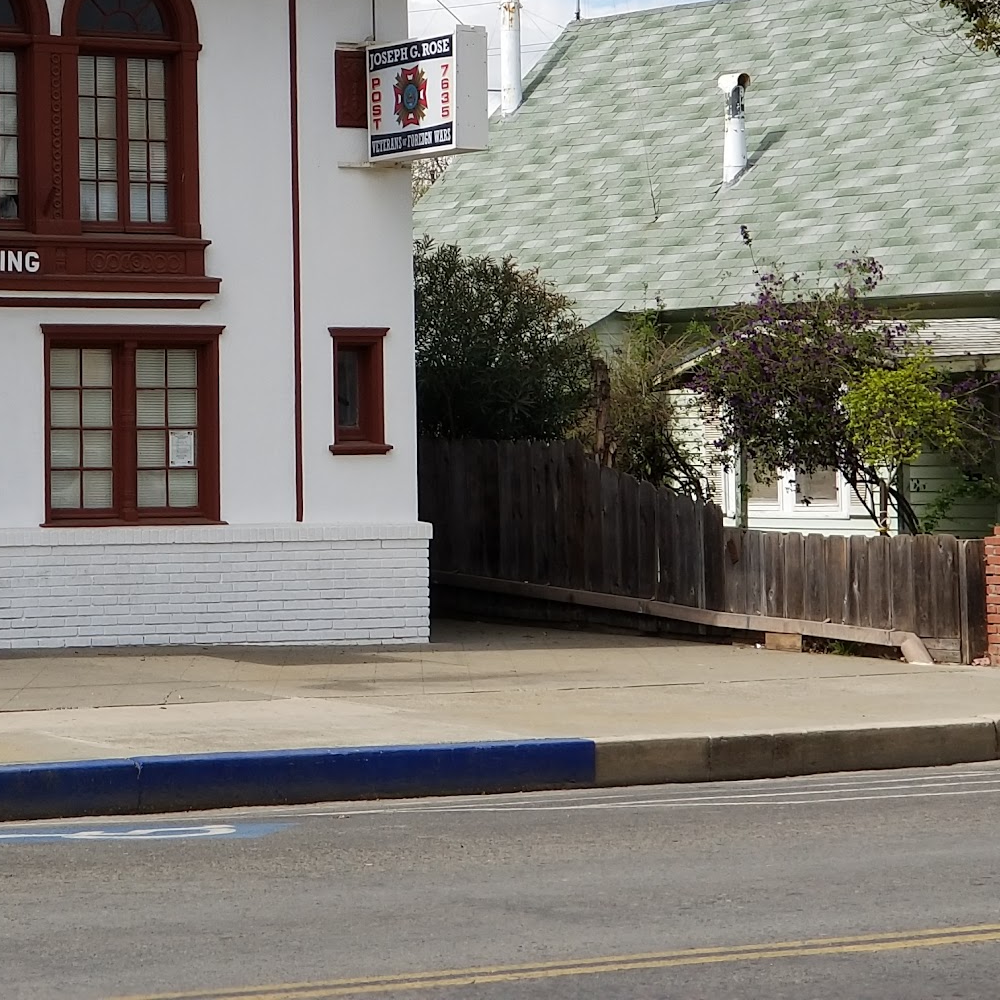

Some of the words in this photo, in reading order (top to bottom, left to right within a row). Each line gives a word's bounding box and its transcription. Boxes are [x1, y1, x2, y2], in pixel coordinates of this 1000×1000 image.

[370, 47, 408, 70] JOSEPH
[410, 45, 420, 58] G.
[421, 38, 450, 57] ROSE
[372, 78, 381, 130] POST
[441, 64, 449, 117] 7635
[371, 136, 402, 154] VETERANS
[407, 131, 433, 148] FOREIGN
[433, 127, 451, 144] WARS
